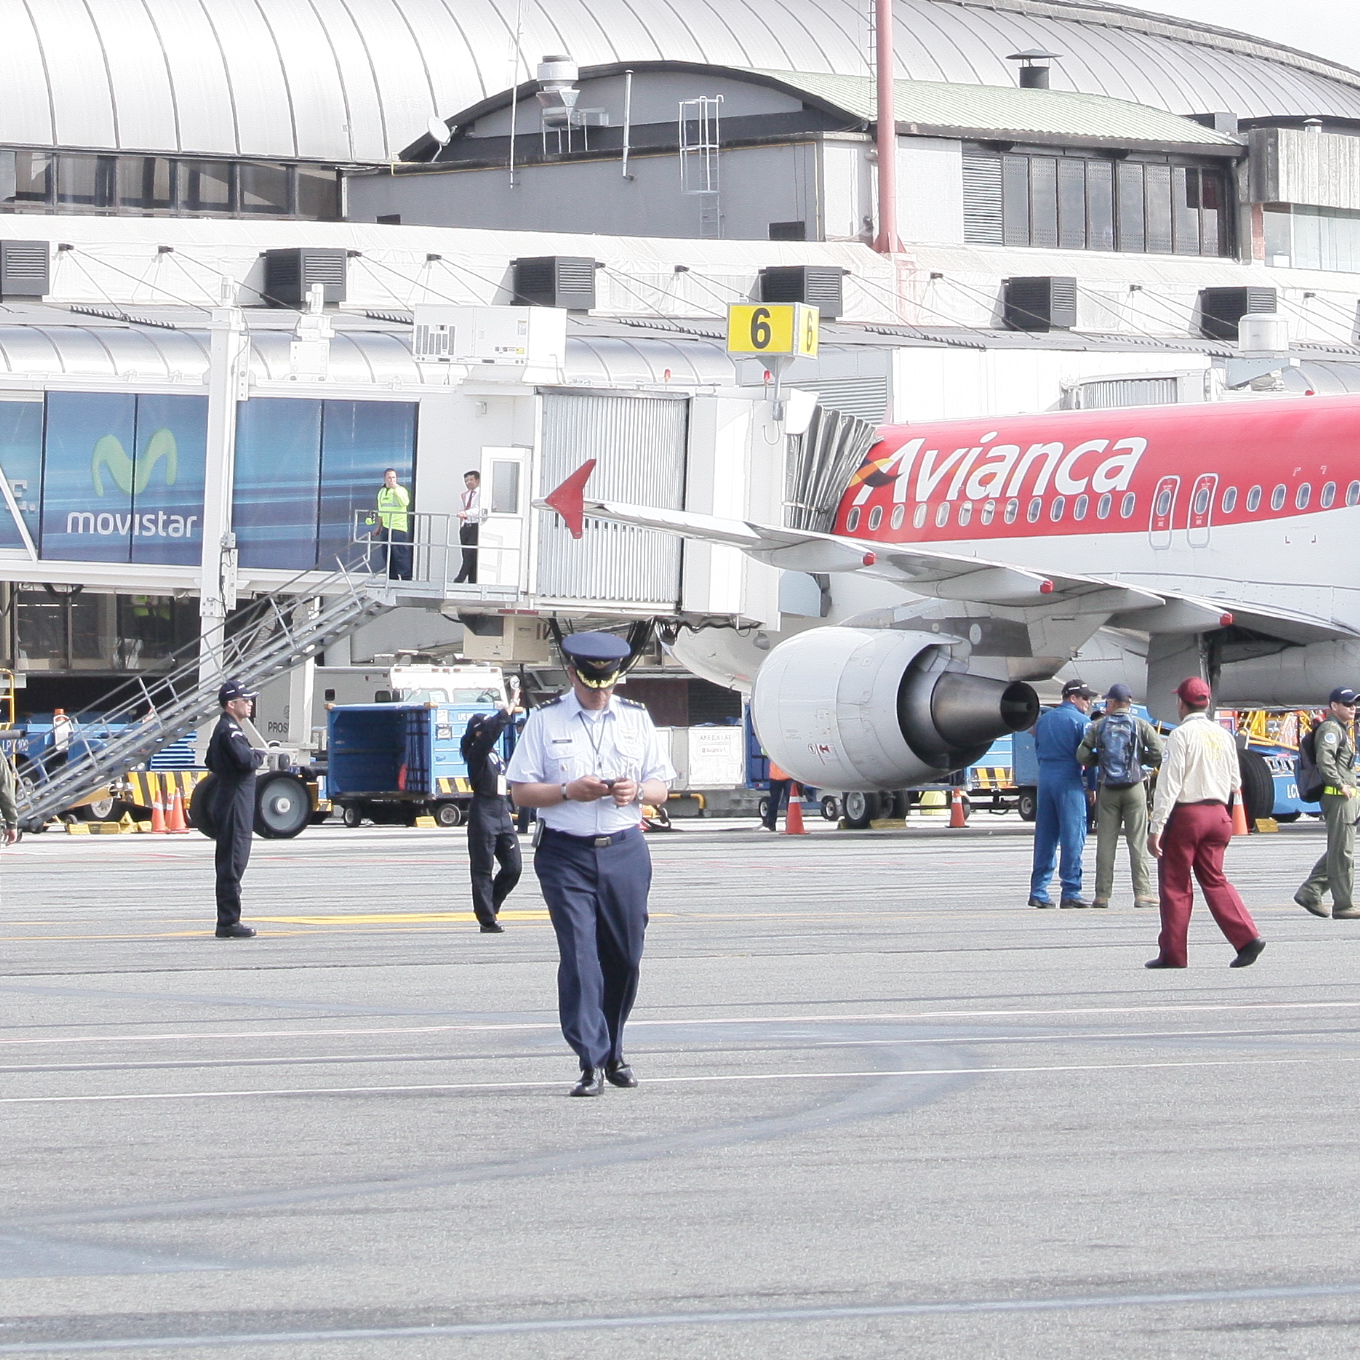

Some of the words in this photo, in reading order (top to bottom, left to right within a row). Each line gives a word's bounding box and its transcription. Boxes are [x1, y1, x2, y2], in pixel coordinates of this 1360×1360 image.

[750, 307, 771, 350] 6
[806, 310, 813, 352] 6
[852, 431, 1148, 506] Avianca
[67, 511, 197, 538] movistar
[267, 721, 290, 733] PROS
